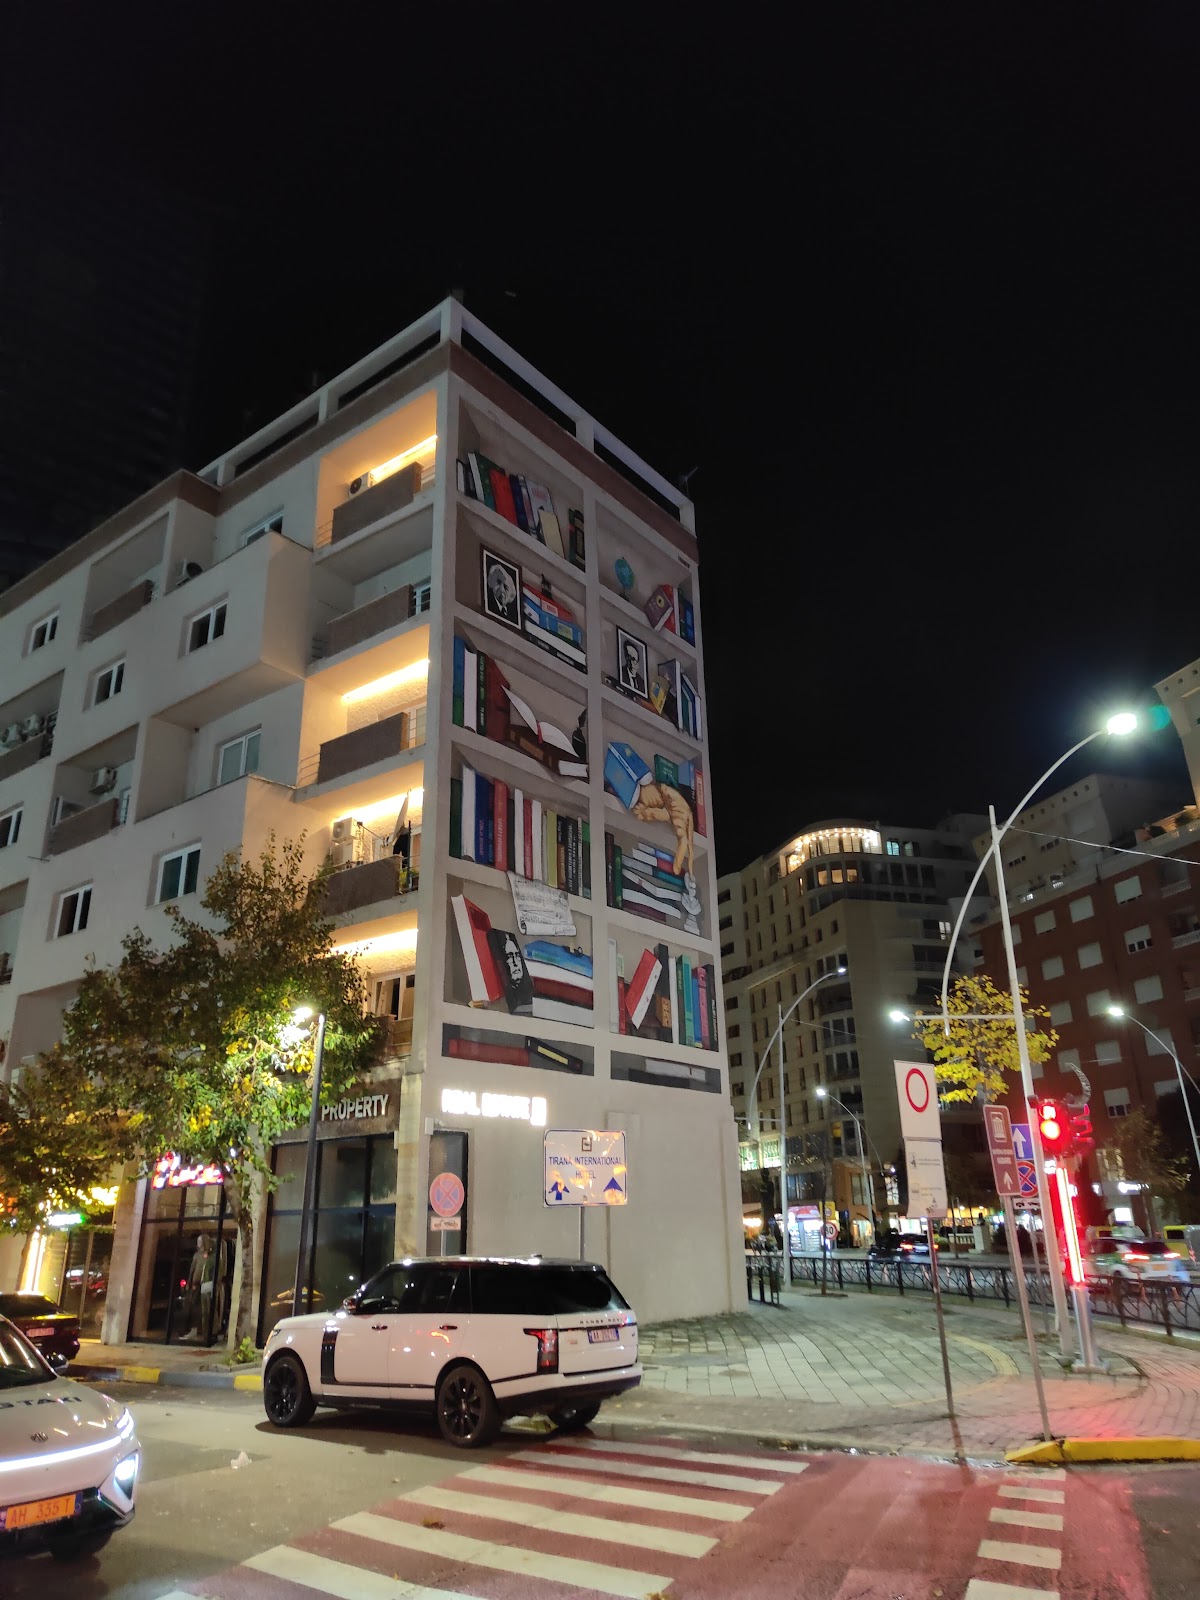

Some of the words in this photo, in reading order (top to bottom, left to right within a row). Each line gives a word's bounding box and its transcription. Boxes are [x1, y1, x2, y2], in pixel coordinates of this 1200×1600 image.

[321, 1093, 389, 1121] PROPERTY
[548, 1156, 573, 1166] TIRANA
[574, 1156, 622, 1166] INTERNATIONAL
[575, 1170, 597, 1179] HOTEL
[64, 1498, 71, 1513] T
